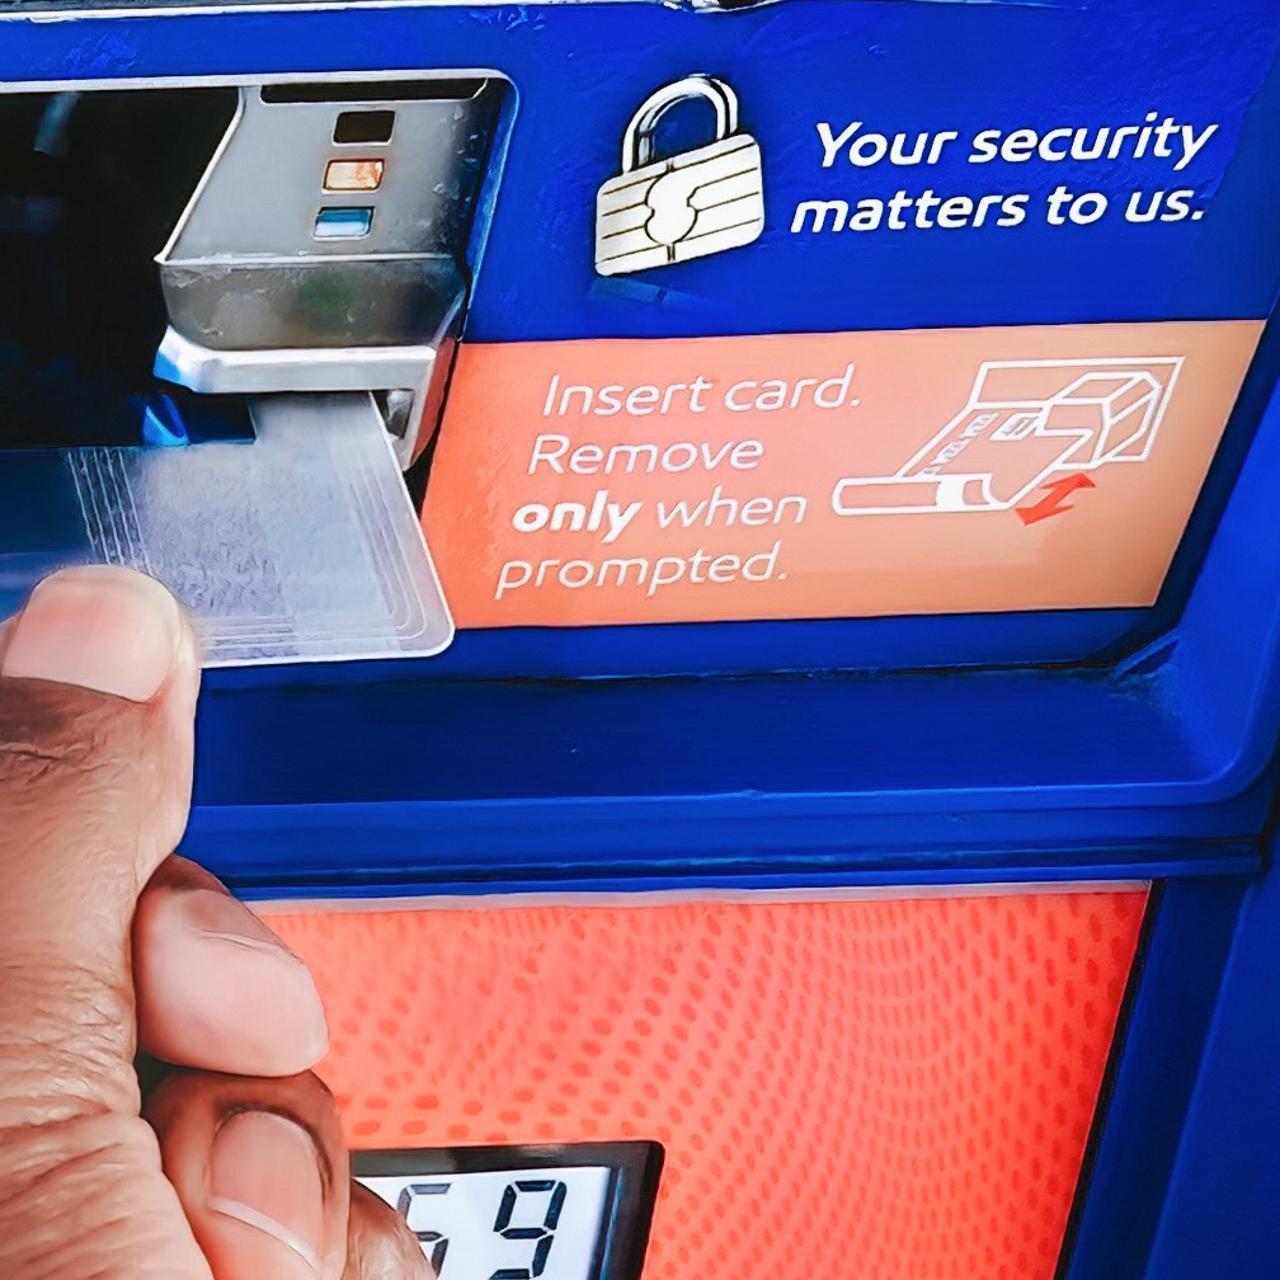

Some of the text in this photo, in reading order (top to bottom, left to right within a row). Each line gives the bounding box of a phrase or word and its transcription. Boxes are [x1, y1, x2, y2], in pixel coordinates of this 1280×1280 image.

[816, 111, 1219, 172] Your security
[790, 186, 1206, 233] matters to us.
[543, 363, 862, 416] Insert card.
[528, 433, 765, 474] Remove
[512, 489, 809, 542] only when
[495, 540, 790, 600] prompted.
[396, 1179, 568, 1280] 59
